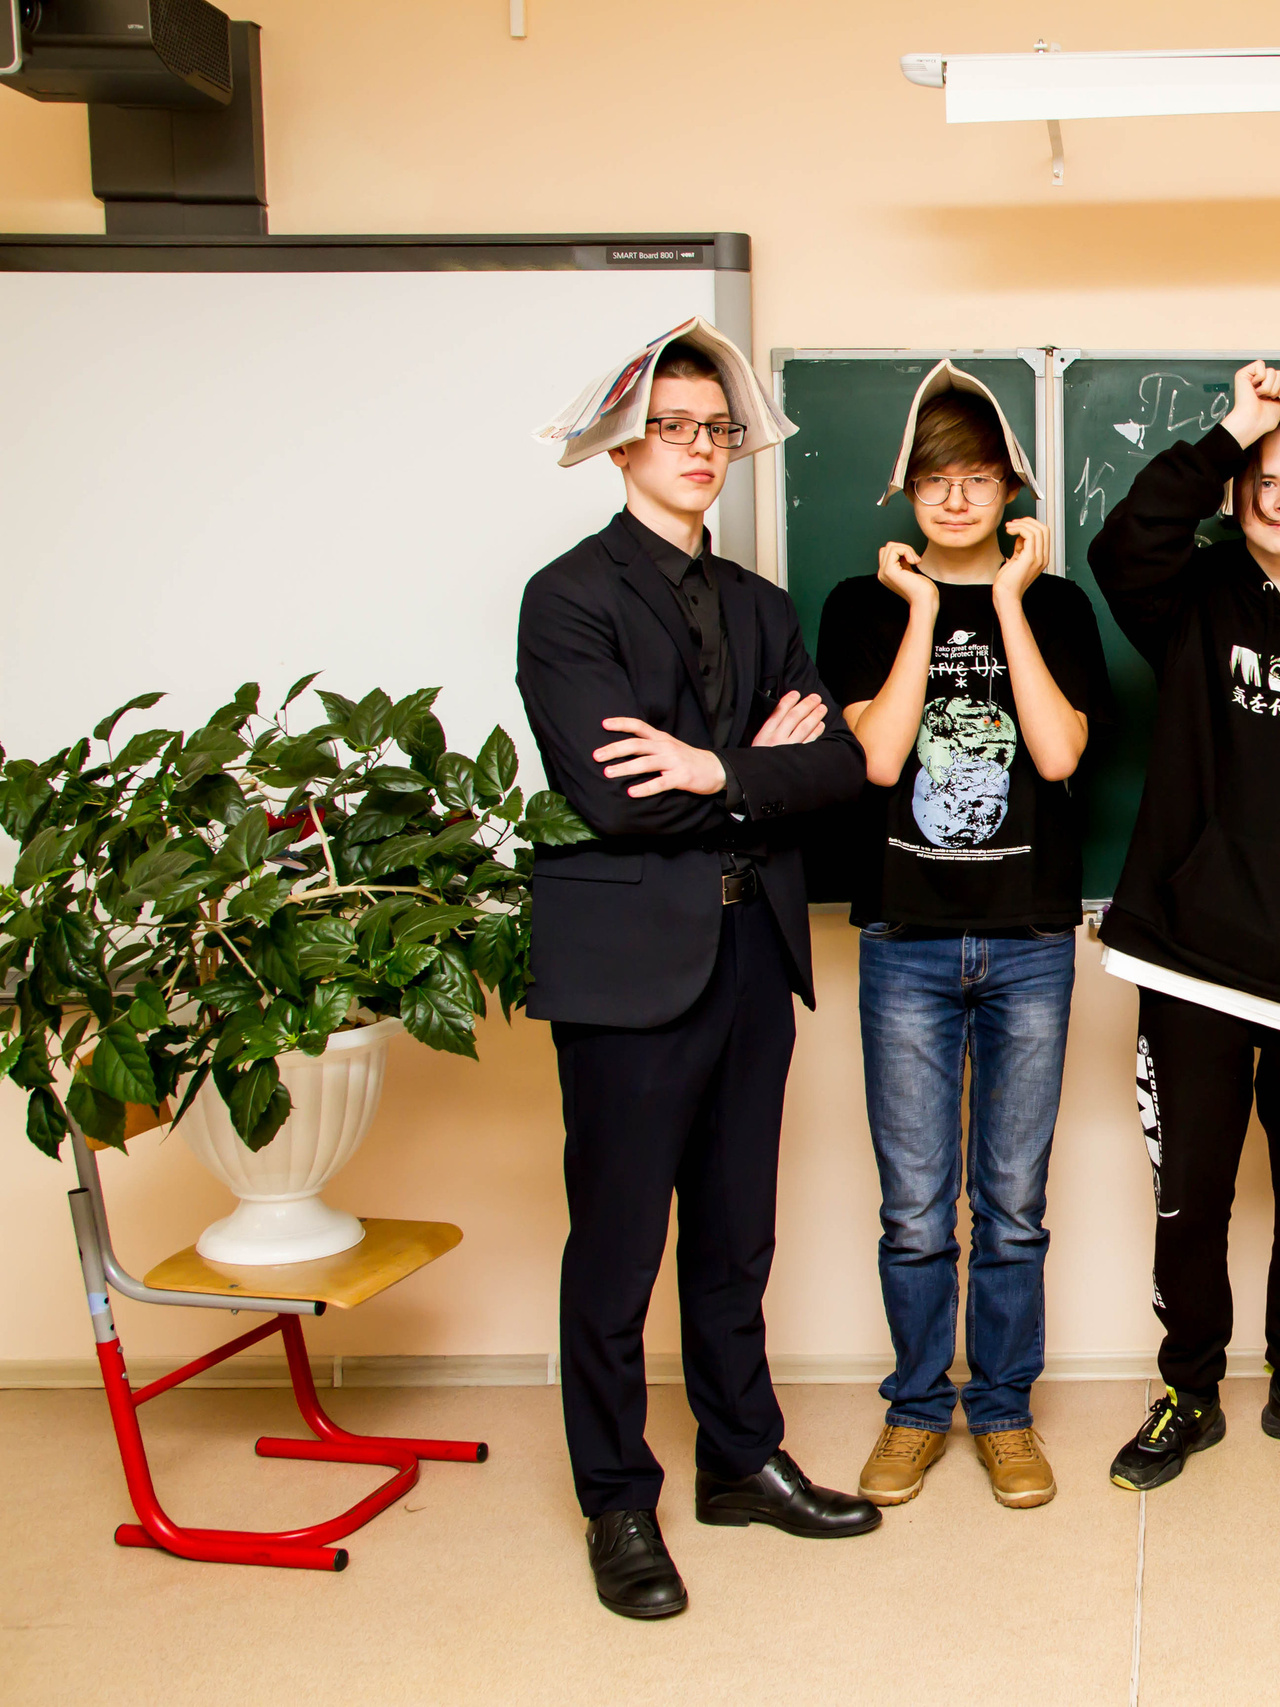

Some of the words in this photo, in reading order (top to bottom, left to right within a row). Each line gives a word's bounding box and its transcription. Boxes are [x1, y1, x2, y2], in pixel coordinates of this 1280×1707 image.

[612, 251, 637, 260] SMART
[638, 251, 659, 260] Board
[660, 251, 674, 260] 800
[951, 644, 967, 654] great
[950, 650, 974, 660] protect
